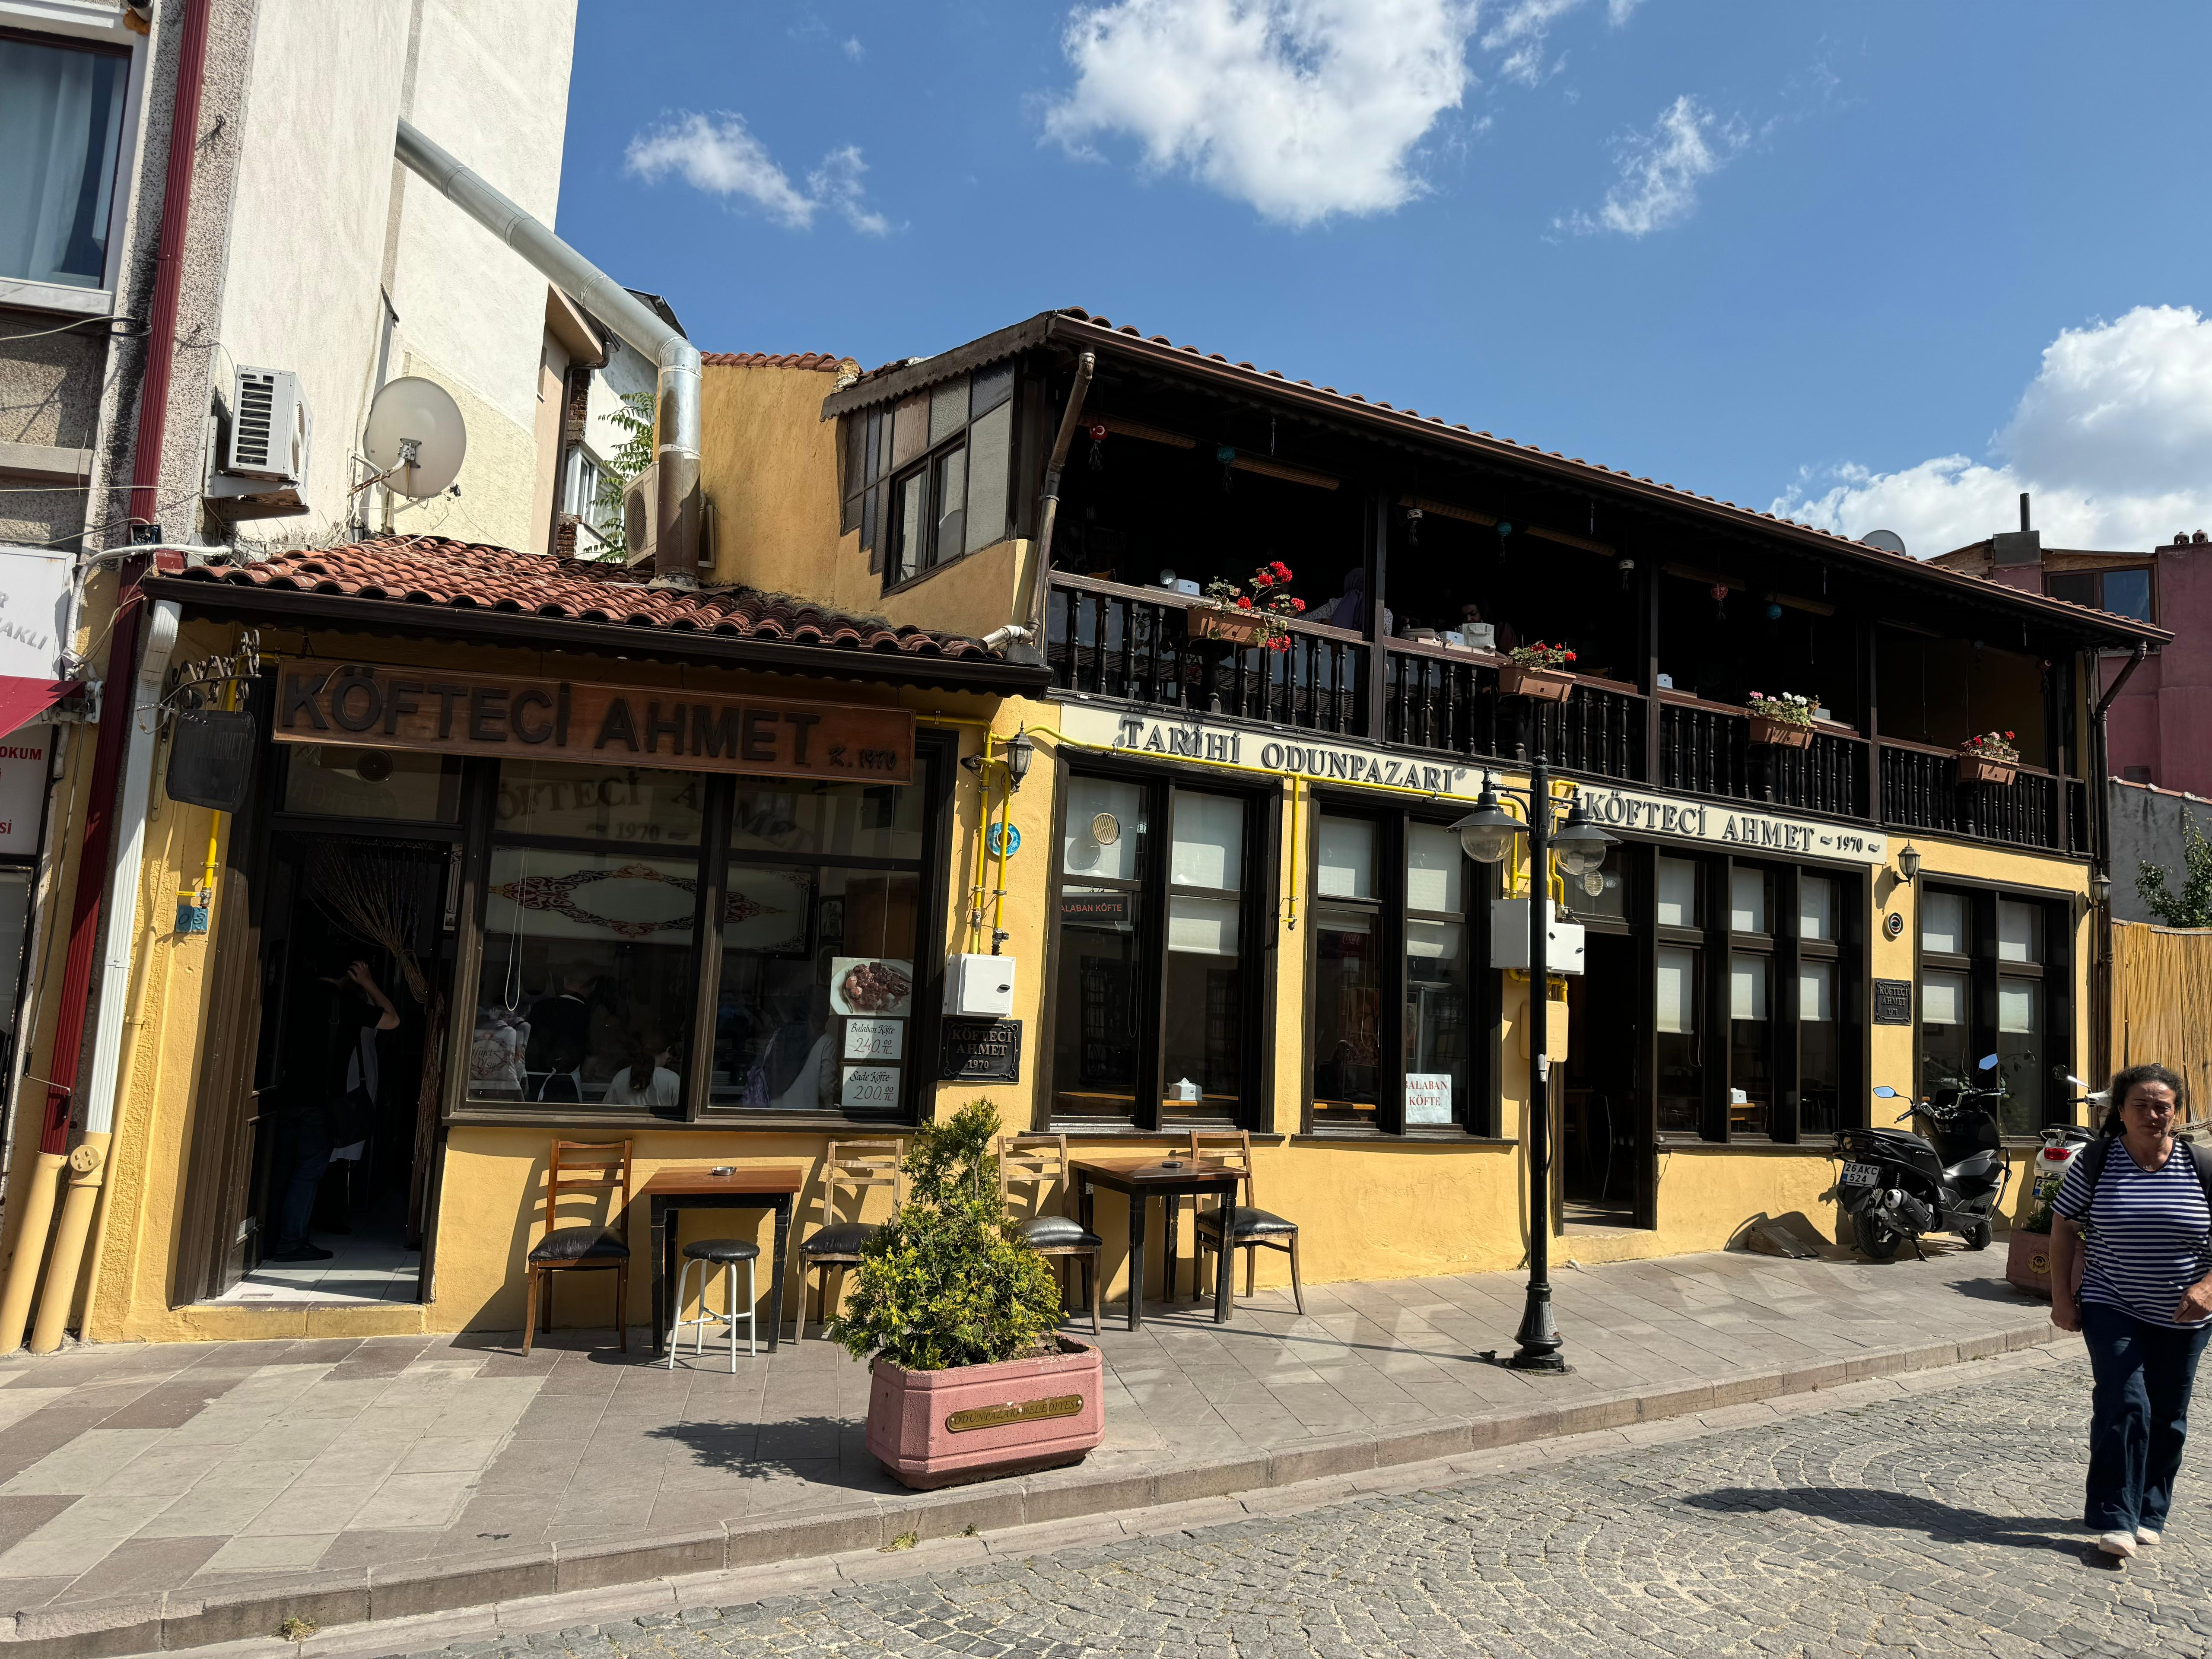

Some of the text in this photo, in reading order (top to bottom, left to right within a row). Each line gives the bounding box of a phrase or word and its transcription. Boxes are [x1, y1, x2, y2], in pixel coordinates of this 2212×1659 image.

[0, 617, 48, 650] AKLI
[282, 665, 820, 769] KÖFTECİ AHMET
[860, 747, 897, 770] 1970
[1124, 719, 1453, 793] TARİHİ ODUNPAZARI
[496, 770, 641, 820] ÖFTECİ
[1585, 791, 1863, 853] KÖFTECİ AHMET 1970
[616, 822, 660, 841] 1970
[1061, 903, 1122, 912] ALABAN KÖFTE
[1882, 997, 1907, 1006] AHMET
[851, 1022, 895, 1037] Balaban Köfte
[950, 1027, 1012, 1042] KÖFTECİ
[955, 1043, 1007, 1056] AHMET
[967, 1059, 989, 1069] 1970
[850, 1071, 892, 1084] Sade Köfte
[1409, 1094, 1441, 1106] KÖFTE
[1850, 1173, 1867, 1183] 524
